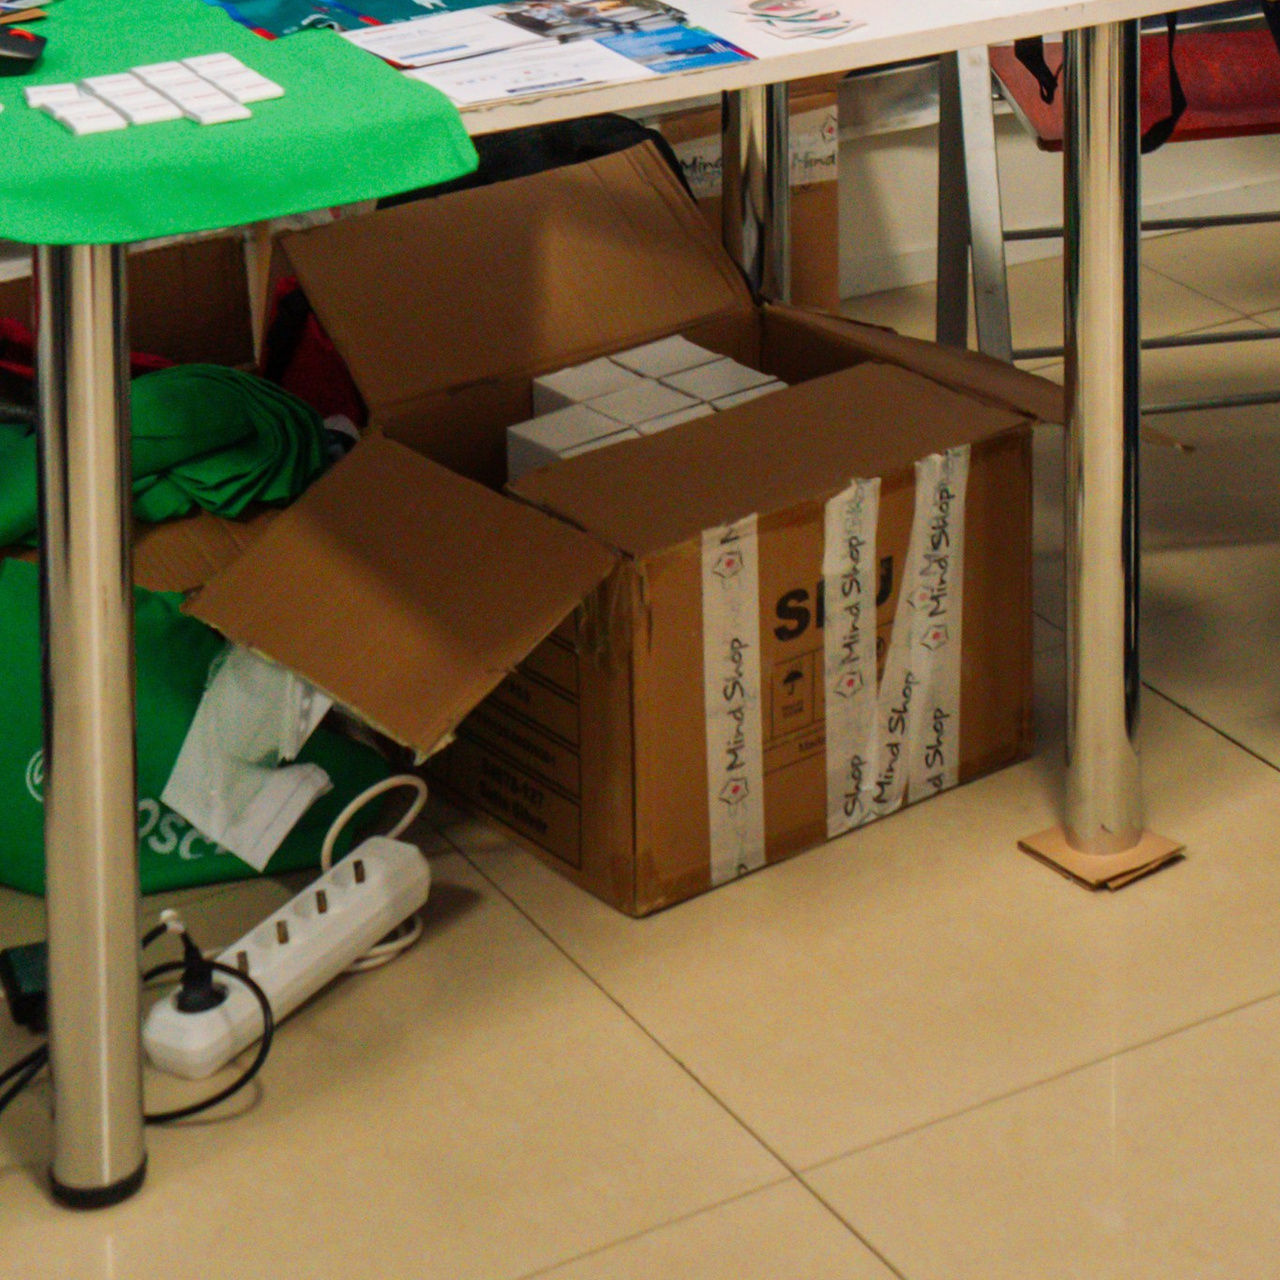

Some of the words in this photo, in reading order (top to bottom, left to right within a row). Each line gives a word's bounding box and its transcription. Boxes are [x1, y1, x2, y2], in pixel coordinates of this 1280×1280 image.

[723, 636, 750, 702] Shop
[725, 706, 746, 772] Mind
[872, 741, 901, 804] Mind
[888, 670, 920, 735] Shop
[925, 706, 950, 769] Shop
[844, 754, 866, 818] Shop
